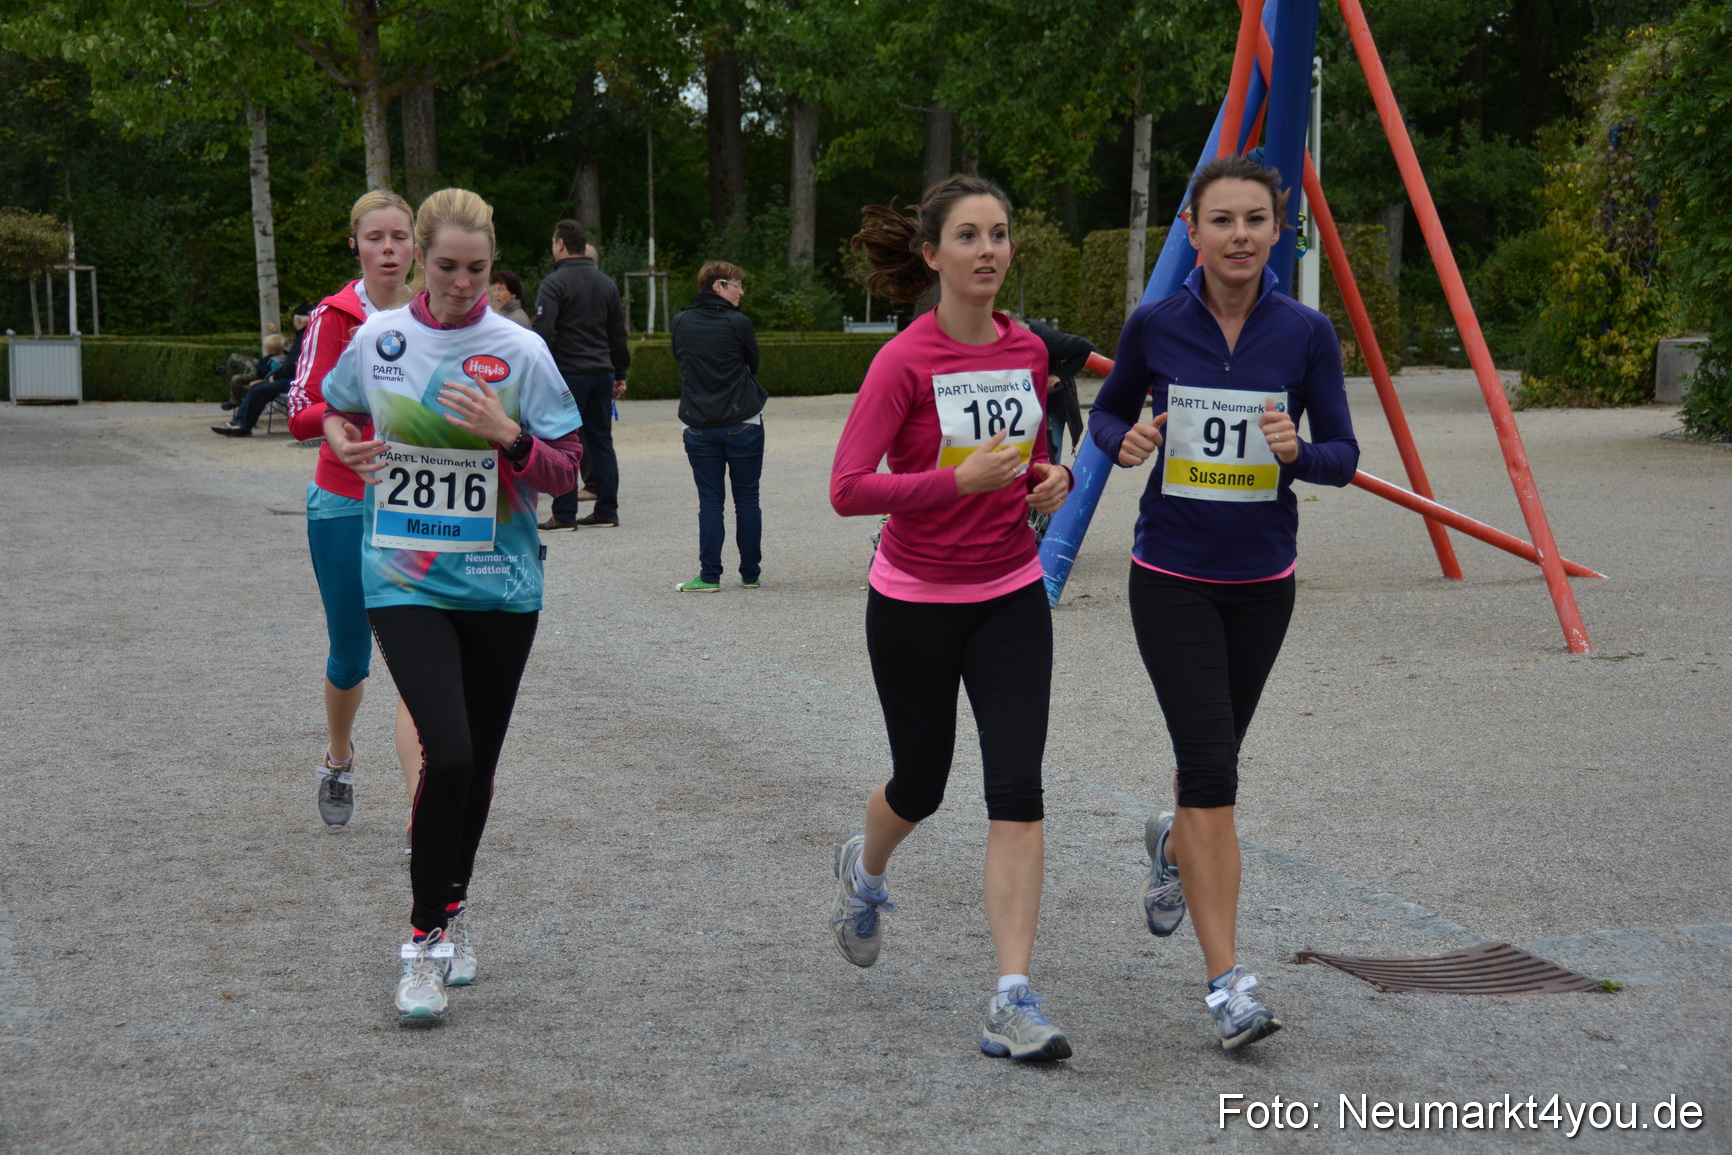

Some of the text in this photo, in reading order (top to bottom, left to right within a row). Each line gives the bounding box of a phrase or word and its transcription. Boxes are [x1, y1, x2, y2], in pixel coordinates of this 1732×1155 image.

[380, 330, 406, 342] BMW
[373, 365, 405, 376] PARTL
[469, 360, 505, 376] Hervis
[373, 374, 404, 382] Neumarkt
[937, 382, 1020, 397] PARTL Neumarkt
[1171, 396, 1265, 414] PARTL Neumark
[963, 397, 1026, 440] 182
[1202, 416, 1248, 459] 91
[379, 451, 477, 468] PARTL Neumarkt
[1189, 466, 1255, 487] Susanne
[387, 467, 487, 512] 2816
[407, 518, 461, 537] Marina
[465, 565, 511, 576] Stadtlauf
